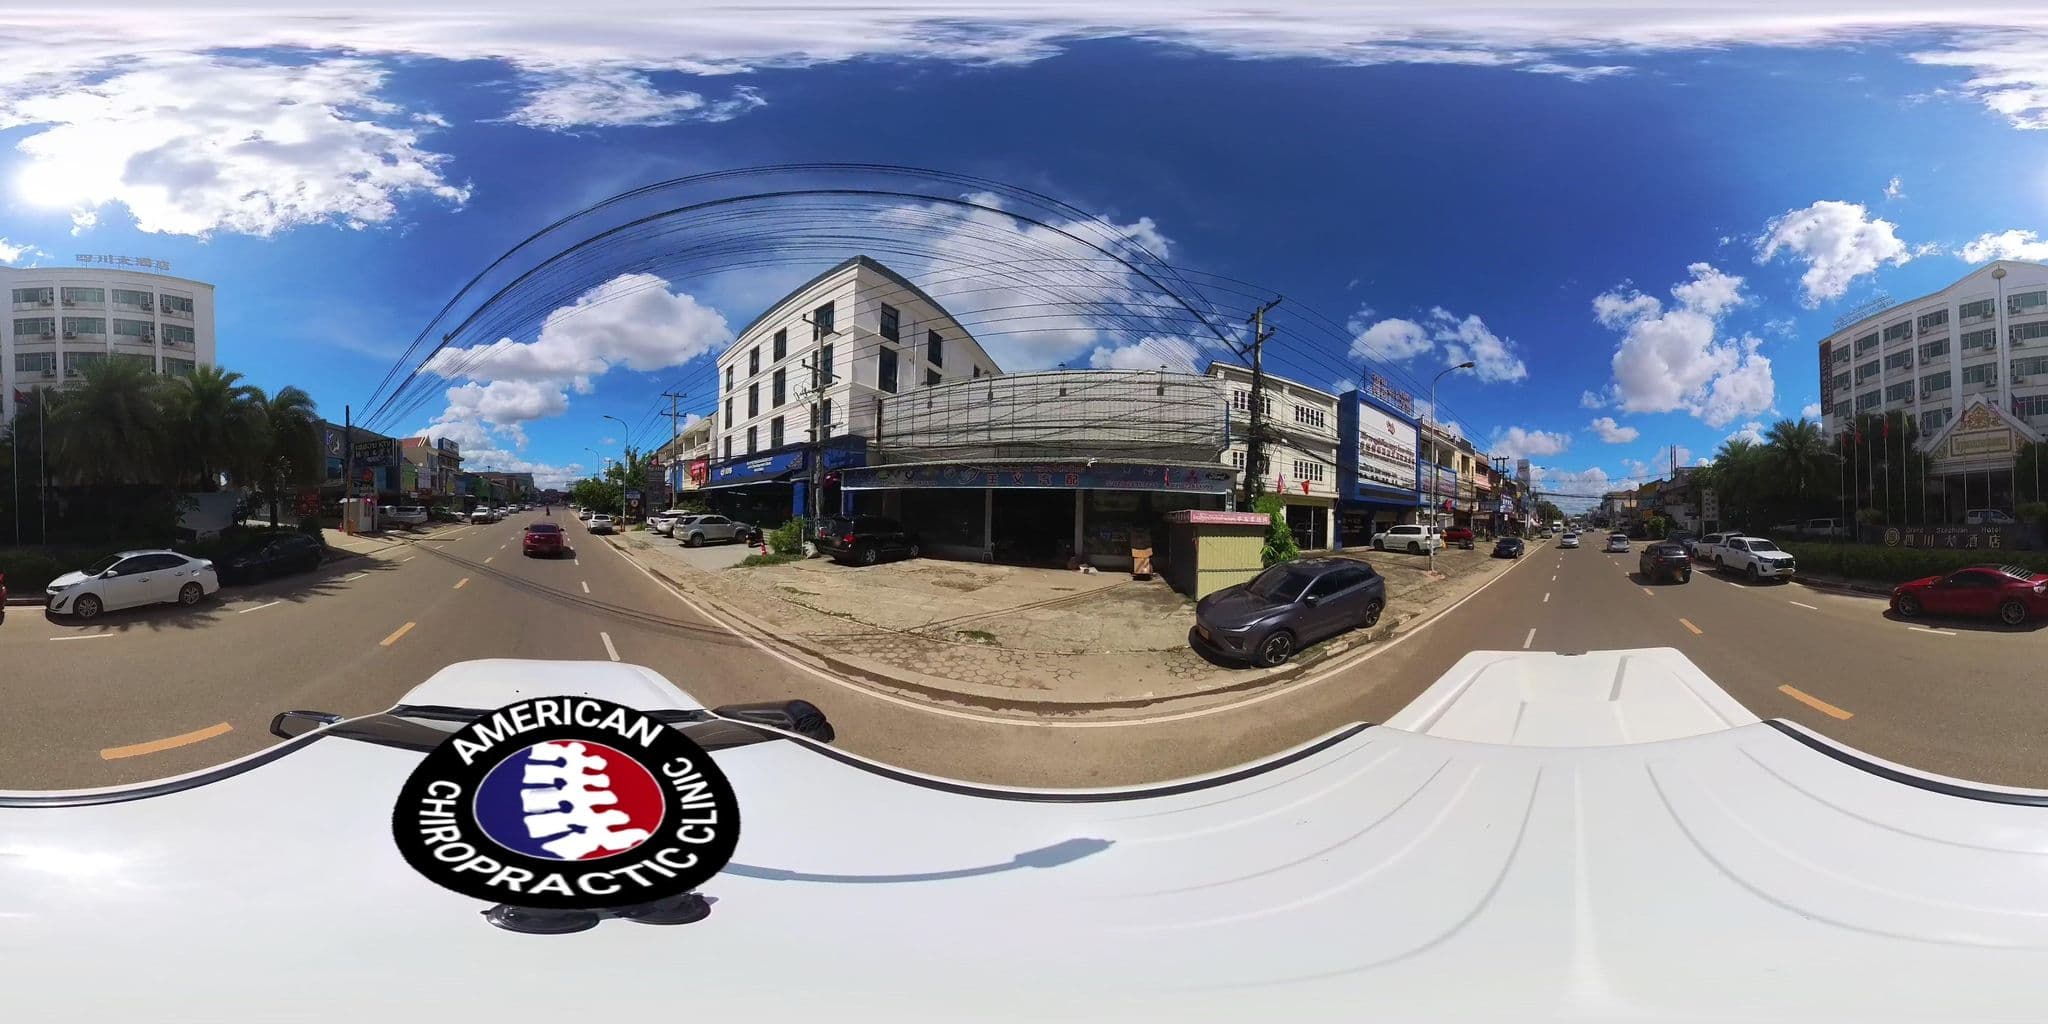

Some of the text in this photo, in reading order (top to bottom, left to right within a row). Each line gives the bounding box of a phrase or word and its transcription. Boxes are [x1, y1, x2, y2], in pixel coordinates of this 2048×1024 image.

[1903, 534, 2001, 550] 四川大酒店
